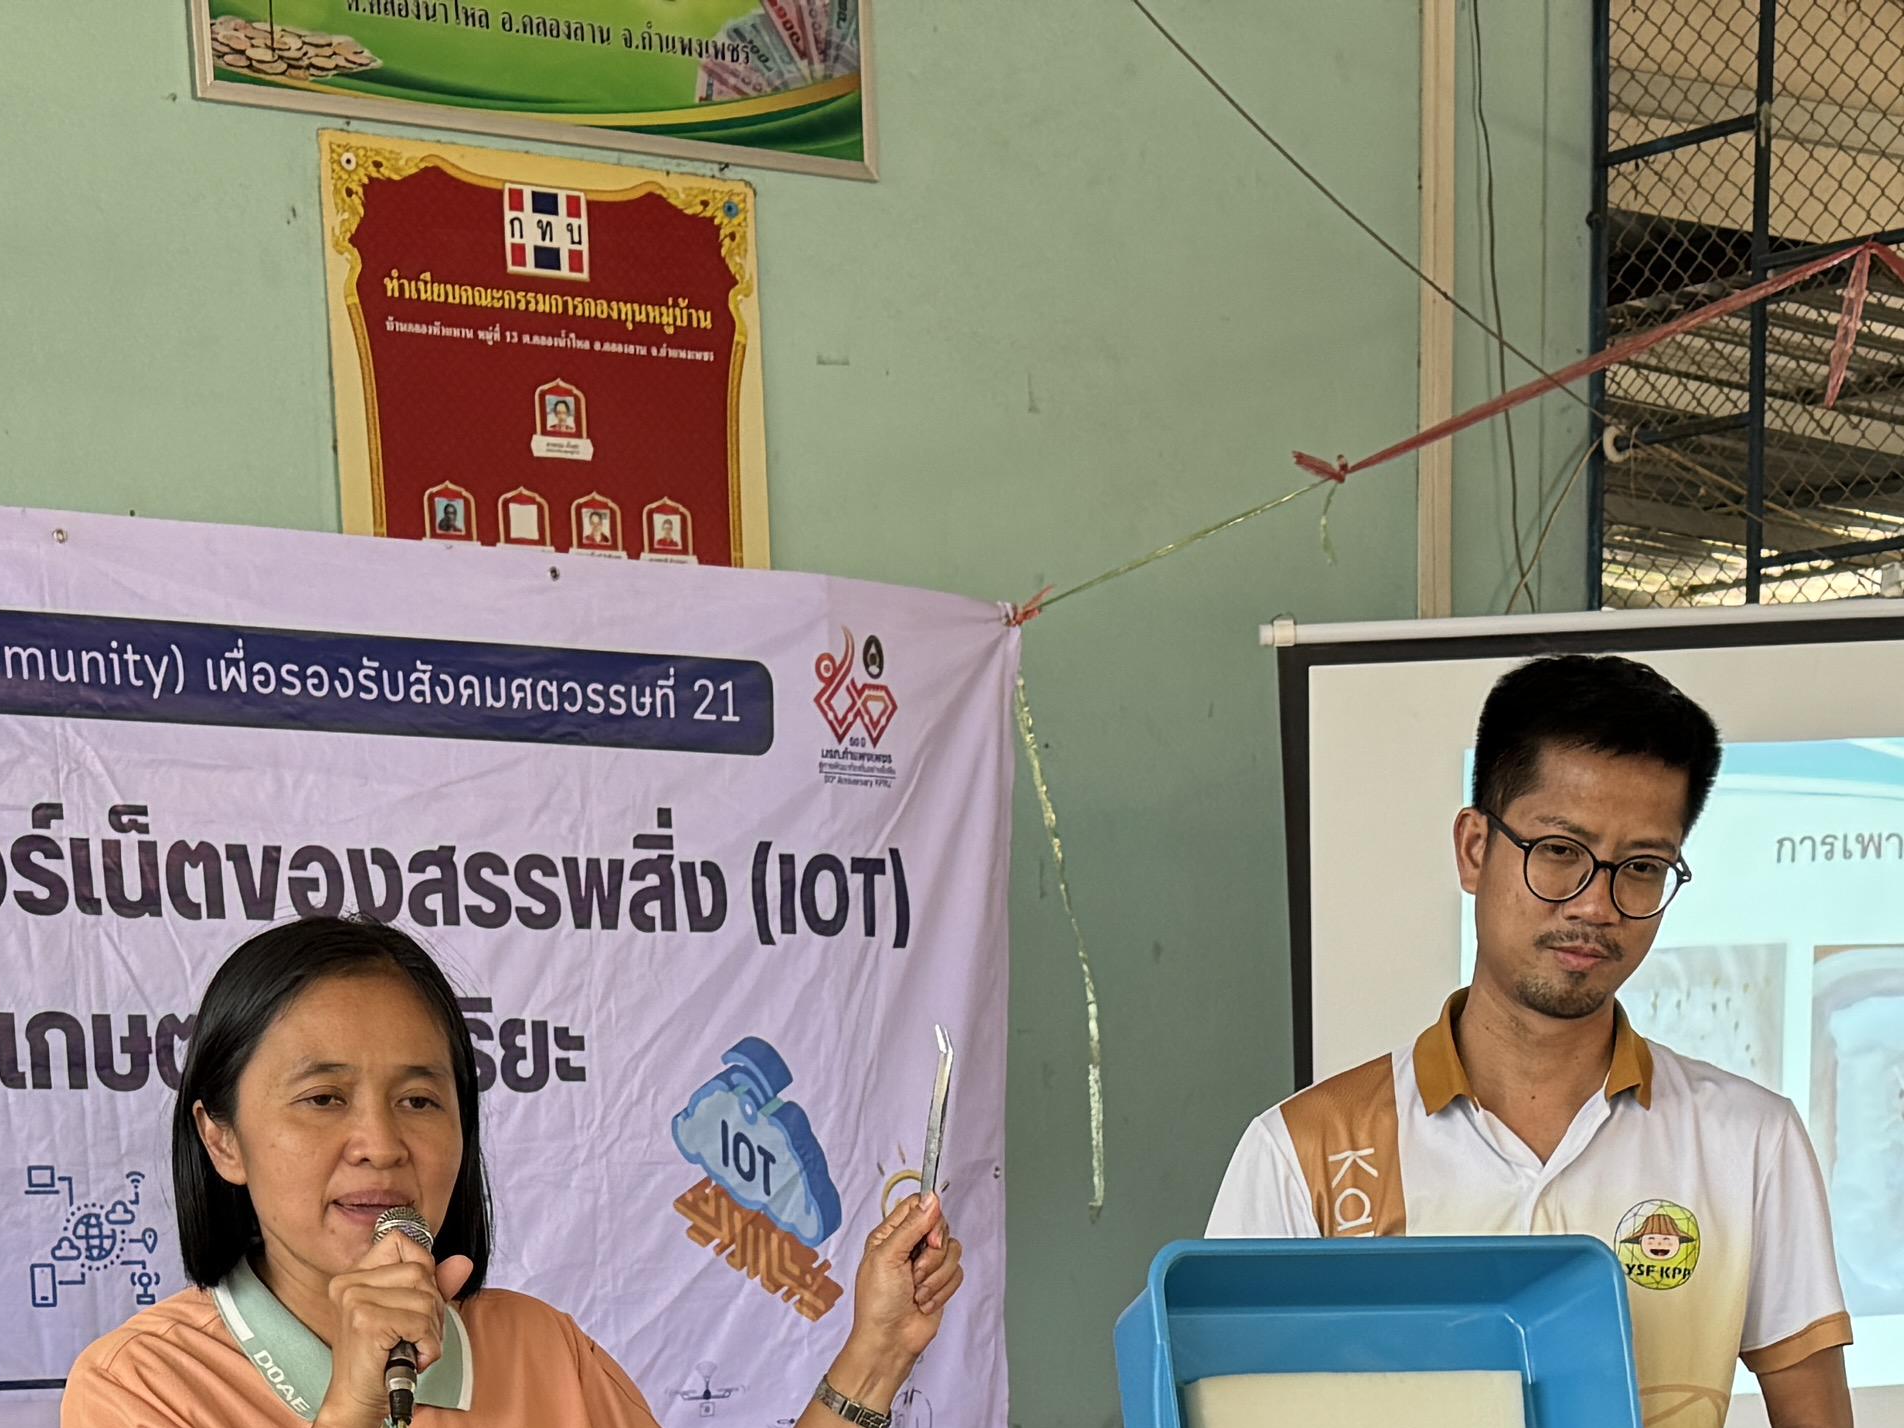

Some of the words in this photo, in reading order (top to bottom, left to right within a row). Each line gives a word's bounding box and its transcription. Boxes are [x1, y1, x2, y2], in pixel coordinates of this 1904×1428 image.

[501, 11, 611, 45] อ.คลองลาน
[621, 21, 750, 65] จ.กำแพงเพชร
[509, 216, 524, 239] ก
[536, 218, 554, 243] ท
[566, 222, 583, 246] บ
[384, 268, 712, 335] ทำเนียบคณะกรรมการกองทุนหมู่บ้าน
[204, 638, 677, 721] เพื่อรองรับสังคมศตวรรษที่
[692, 679, 743, 723] 21
[752, 838, 910, 949] (IOT)
[721, 1118, 776, 1197] IOT
[1328, 1147, 1379, 1237] Ka
[254, 1350, 311, 1414] DOAE
